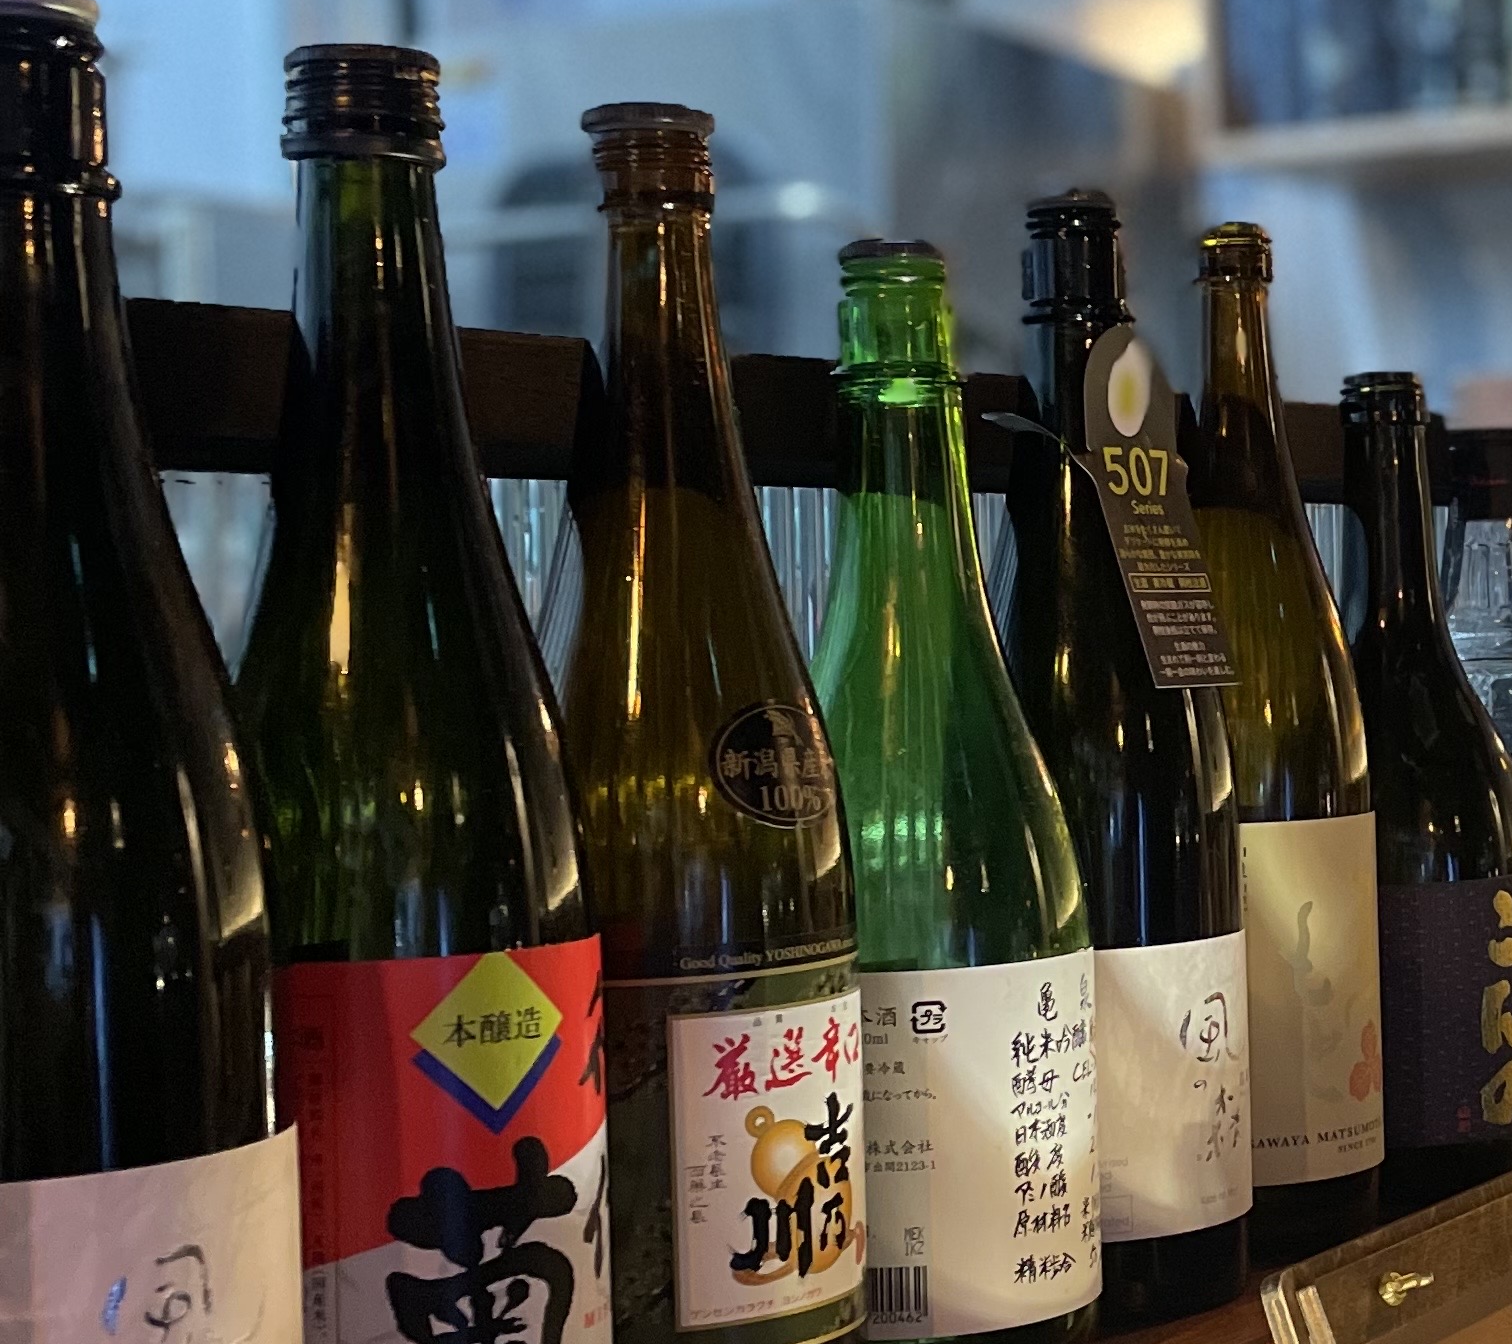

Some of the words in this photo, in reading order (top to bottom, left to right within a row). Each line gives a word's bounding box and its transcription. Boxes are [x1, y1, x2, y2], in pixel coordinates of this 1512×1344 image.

[1103, 446, 1168, 496] 507
[1131, 500, 1165, 516] Series
[759, 785, 821, 812] 100%
[679, 956, 715, 970] Good
[718, 952, 762, 968] Quality
[442, 1006, 543, 1048] 本醸造
[919, 1009, 944, 1026] プラ
[701, 1015, 860, 1102] 厳選辛口
